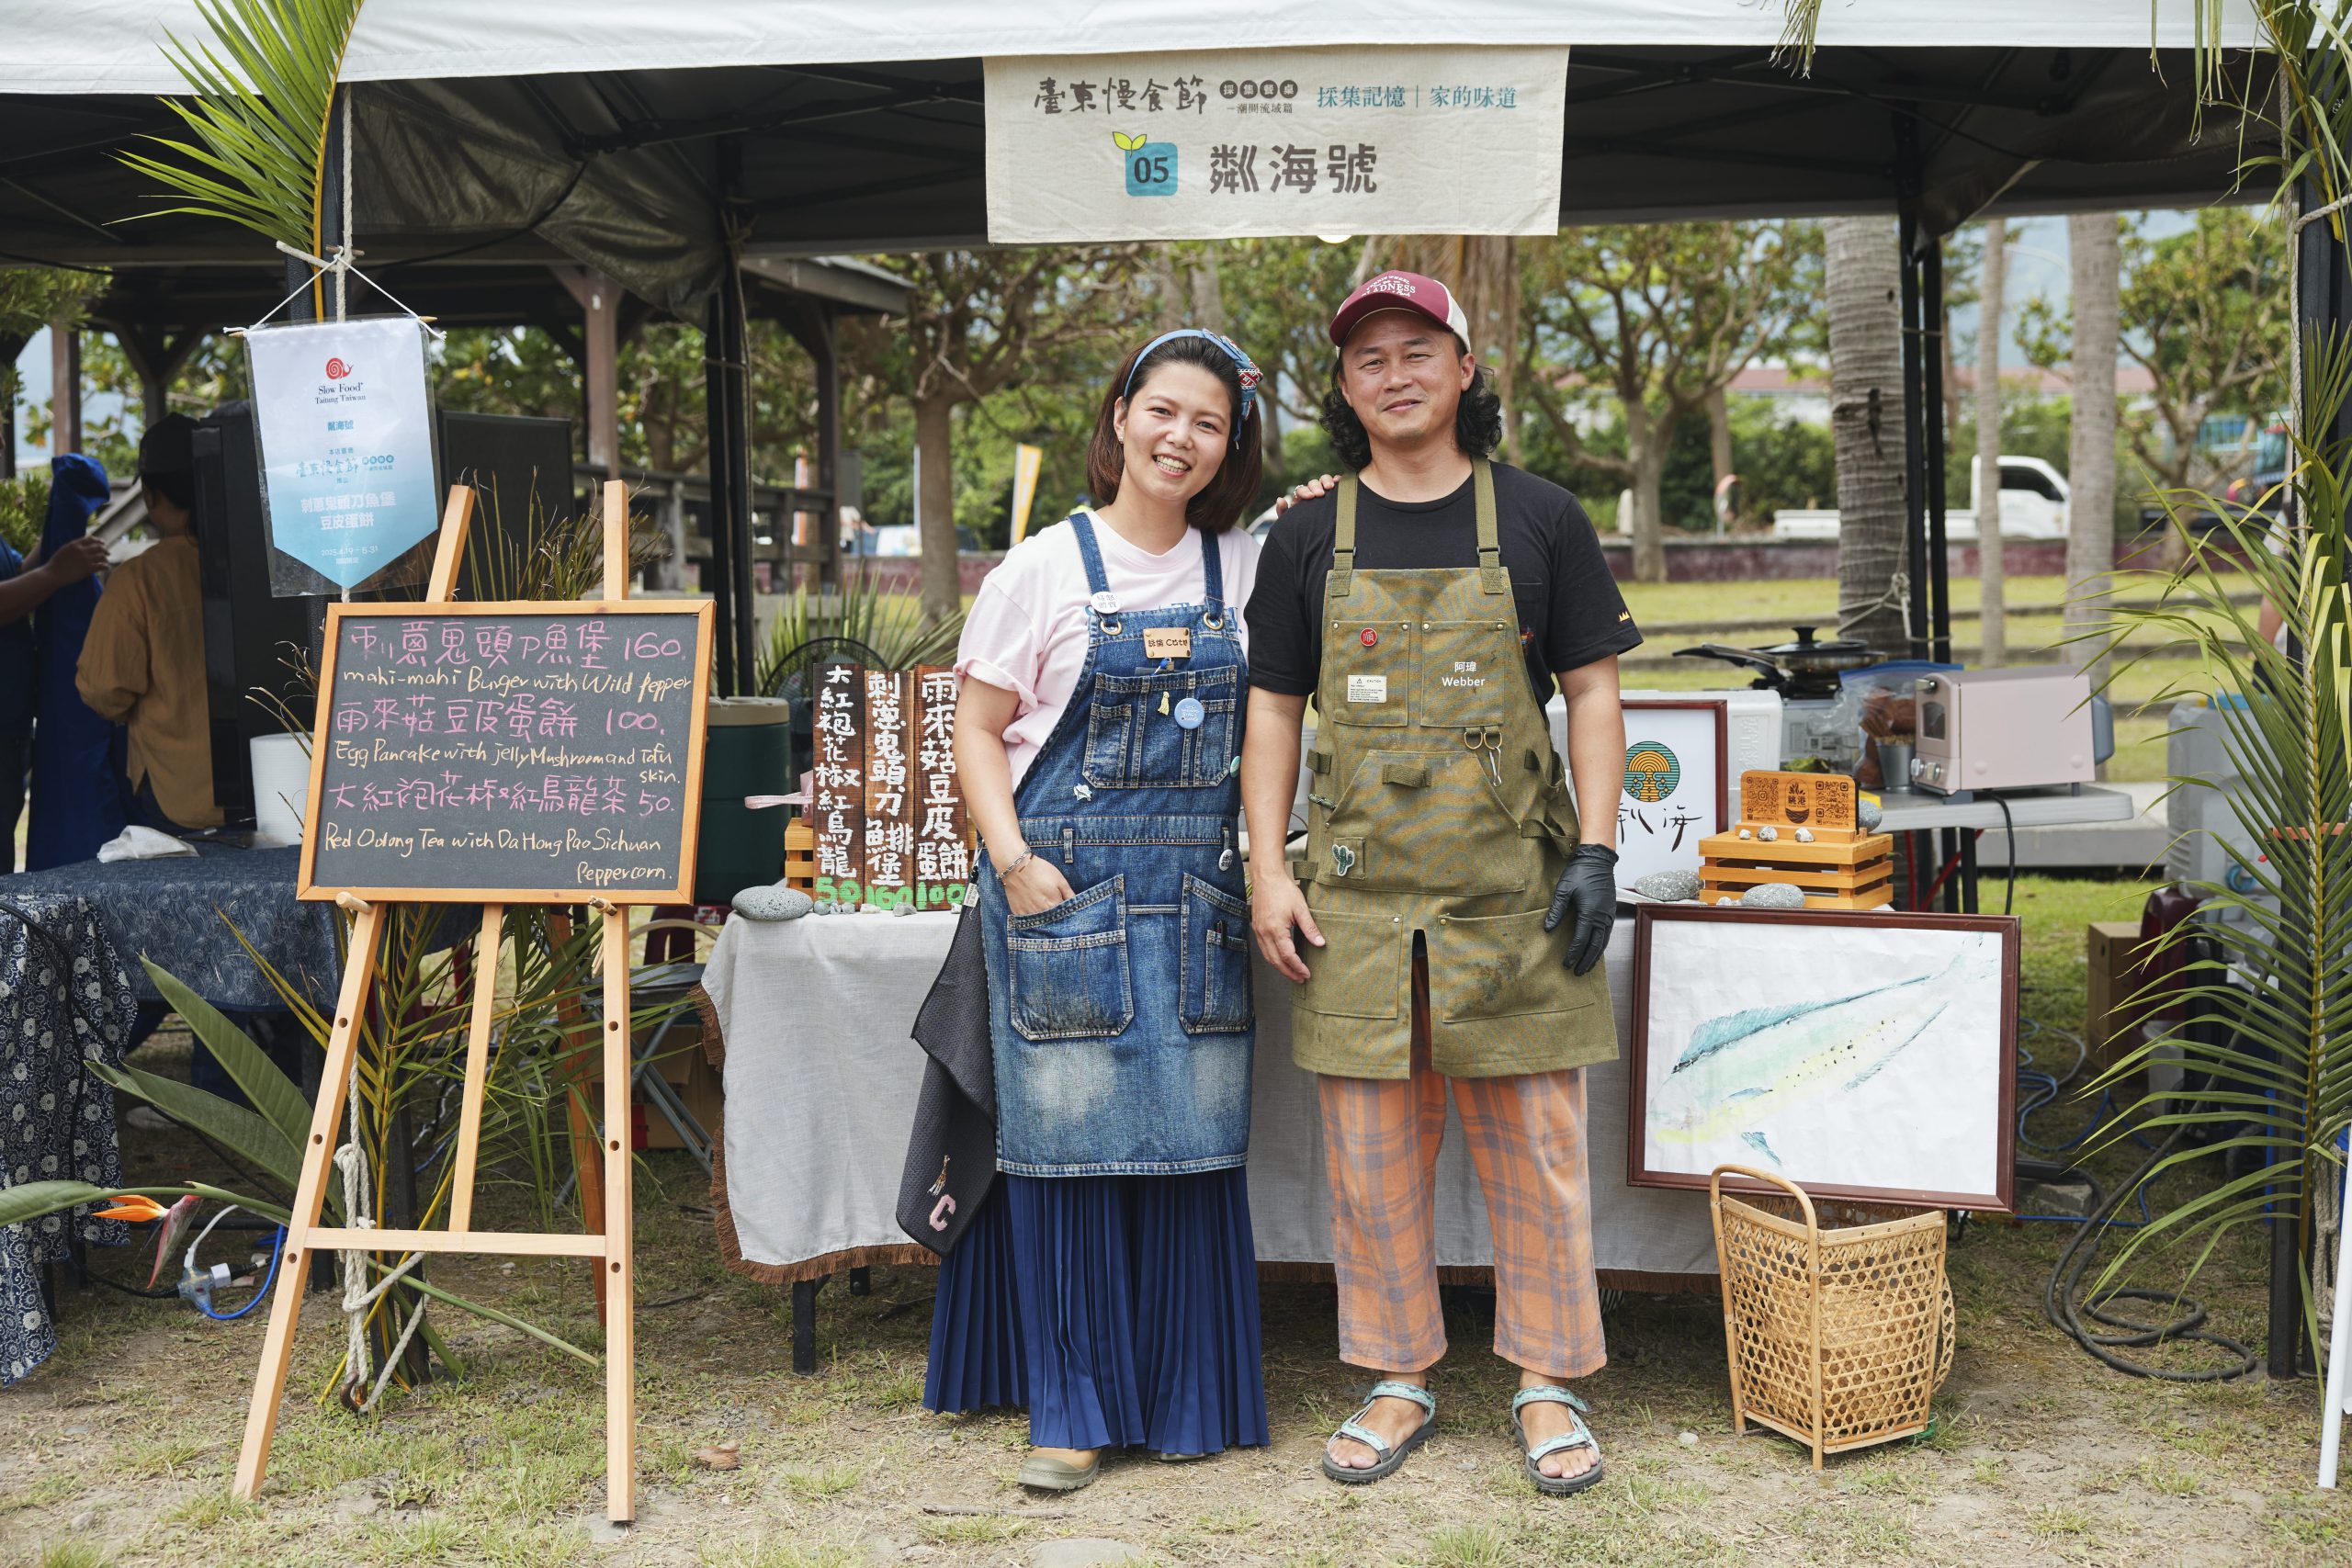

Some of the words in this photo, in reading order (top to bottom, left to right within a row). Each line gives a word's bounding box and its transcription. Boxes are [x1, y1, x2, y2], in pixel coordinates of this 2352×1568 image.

[1035, 74, 1207, 115] 臺東慢食節
[1134, 156, 1170, 184] 05
[1367, 283, 1416, 294] ADNESS
[314, 396, 339, 404] Taitung
[340, 394, 366, 402] Taiwan
[318, 385, 336, 395] Slow
[343, 666, 462, 686] mahi-mahi
[468, 666, 530, 698] Burger
[533, 671, 578, 693] with
[582, 671, 634, 694] Wild
[1442, 676, 1486, 687] Webber
[334, 739, 369, 769] Egg
[373, 738, 441, 764] Pancake
[444, 740, 487, 761] with
[491, 742, 530, 769] jelly
[530, 745, 604, 768] Mushroom
[605, 748, 635, 765] and
[639, 742, 673, 765] Tofu
[324, 821, 352, 852] Red
[356, 828, 413, 858] Oolong
[418, 828, 445, 850] Tea
[451, 831, 494, 850] with
[497, 829, 519, 851] Da
[522, 831, 563, 858] Hong
[566, 828, 592, 852] Pao
[592, 827, 662, 852] Sichuan
[815, 876, 862, 904] 50
[929, 1193, 956, 1232] C
